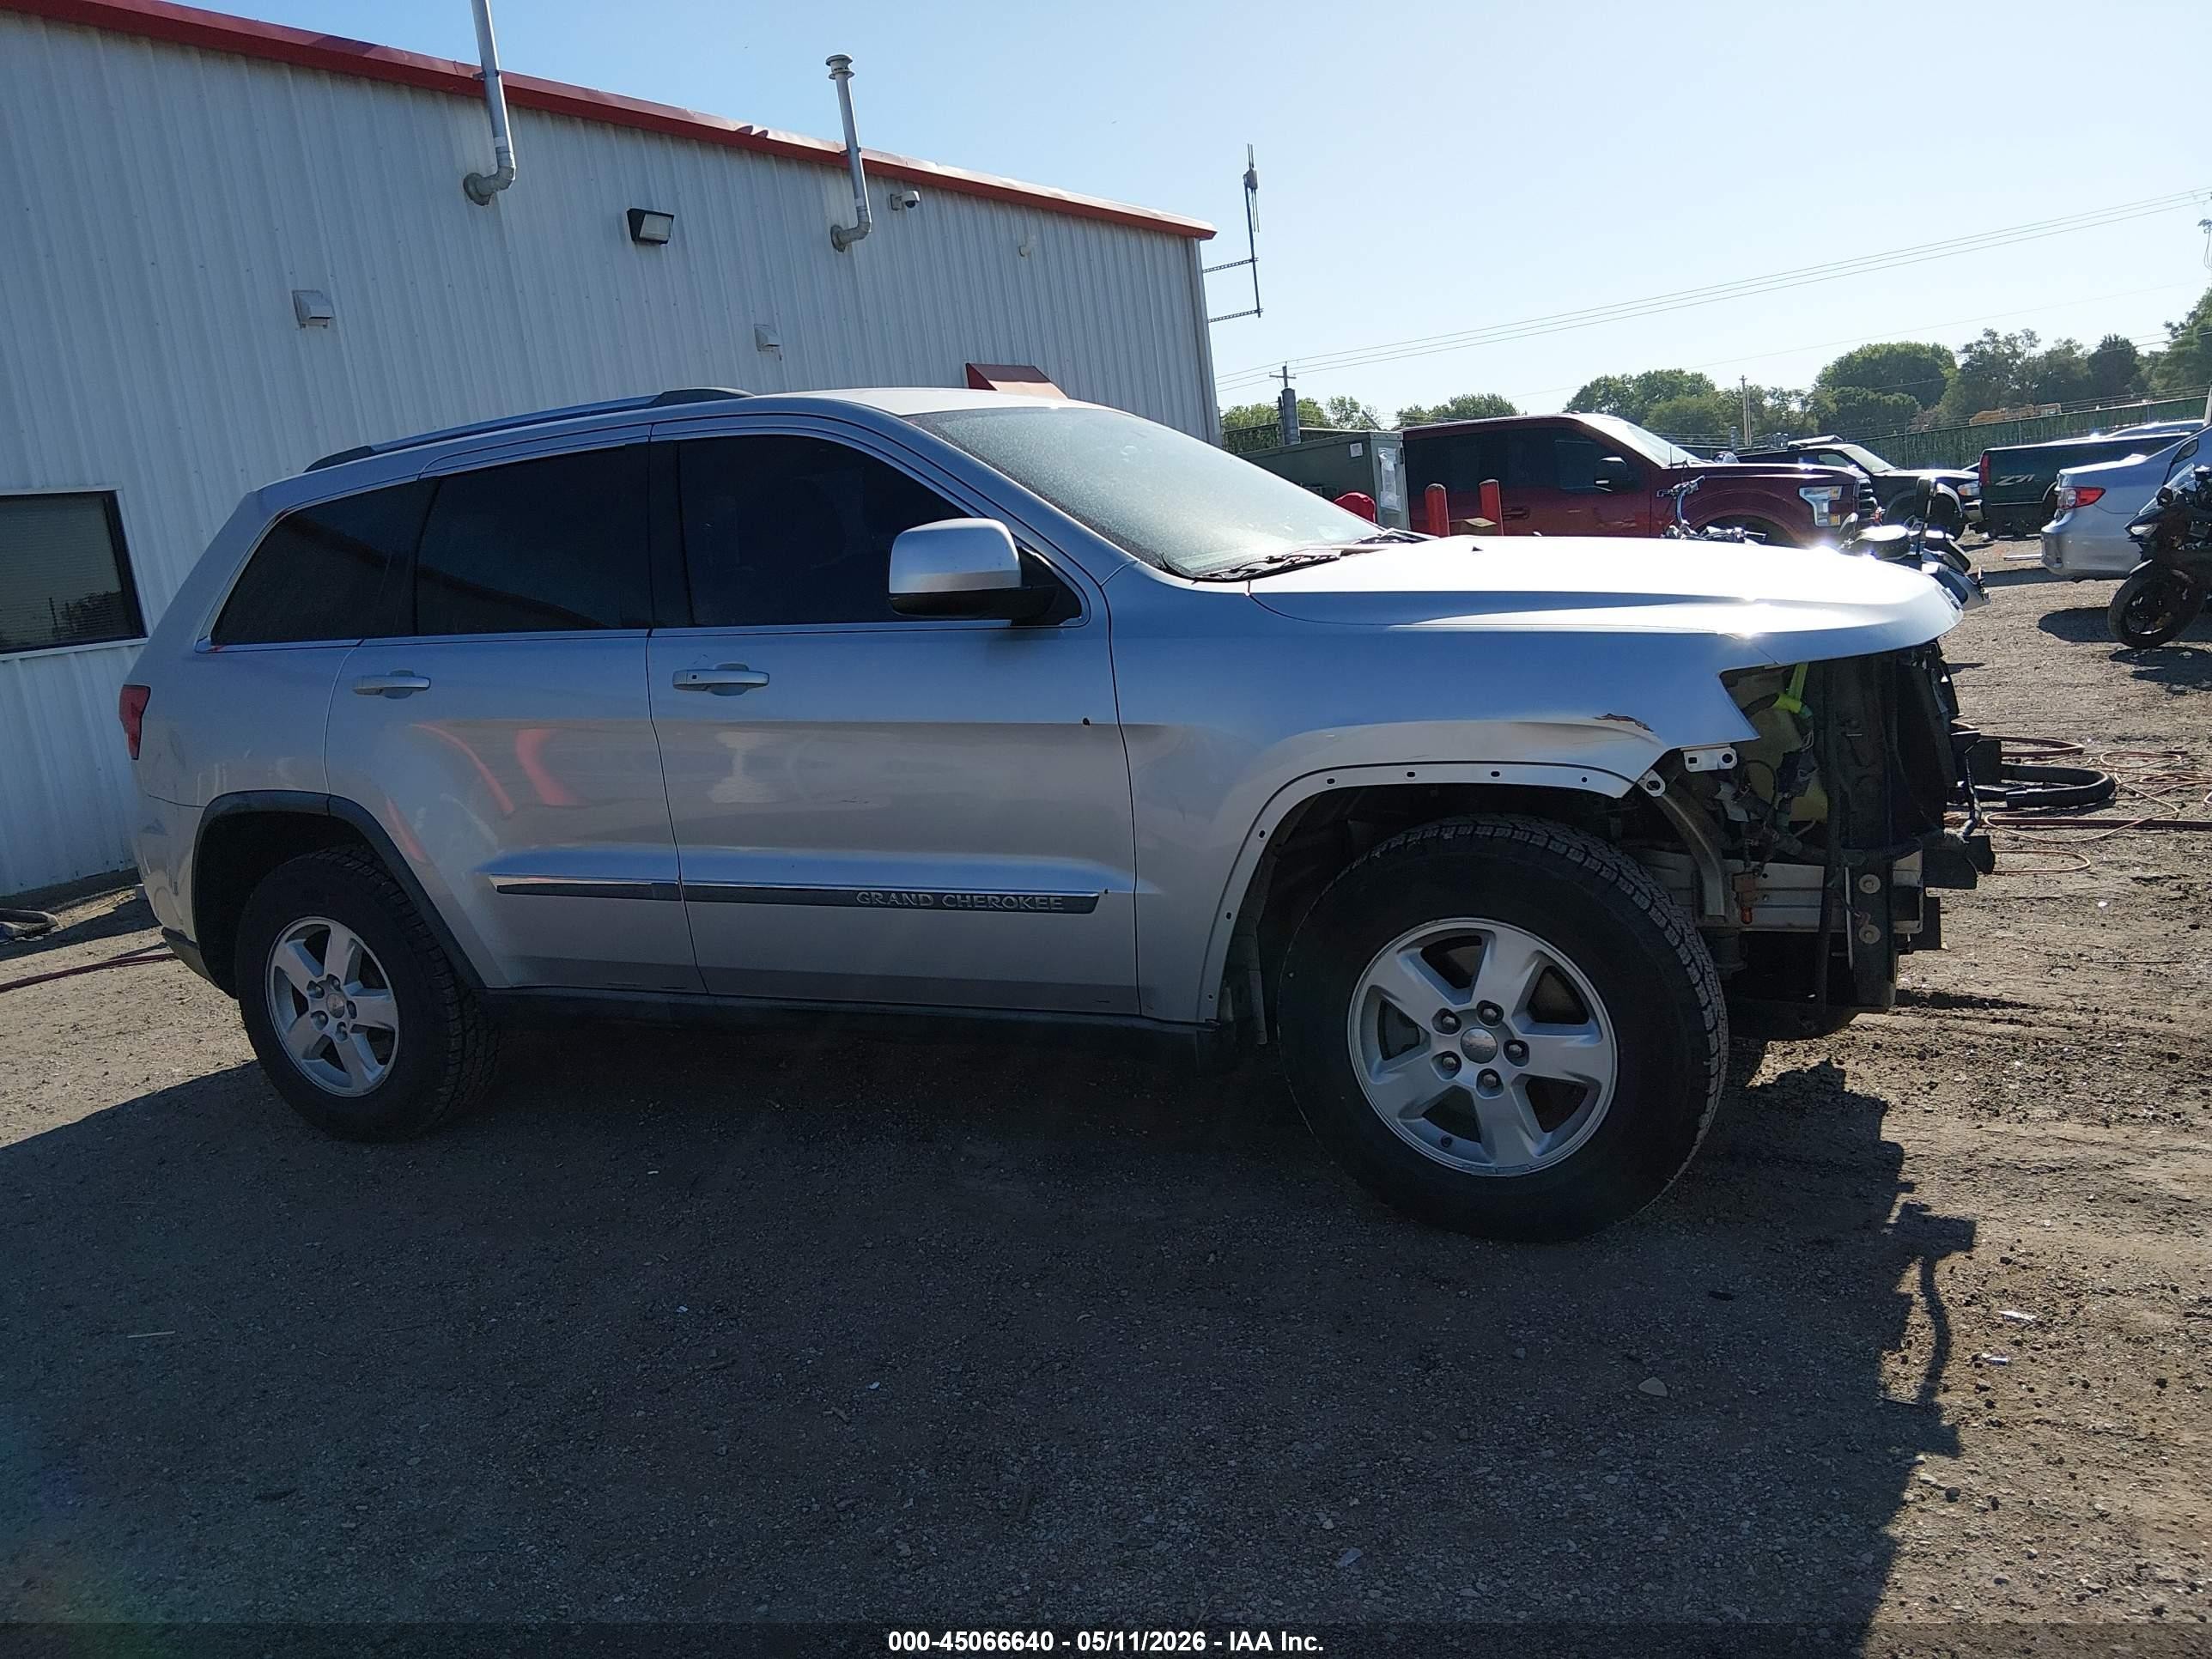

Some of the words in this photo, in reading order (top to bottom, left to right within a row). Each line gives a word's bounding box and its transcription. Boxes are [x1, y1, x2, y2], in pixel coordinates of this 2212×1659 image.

[1996, 473, 2035, 487] Z71
[856, 891, 933, 907] GRAND
[941, 894, 1065, 910] CHEROKEE
